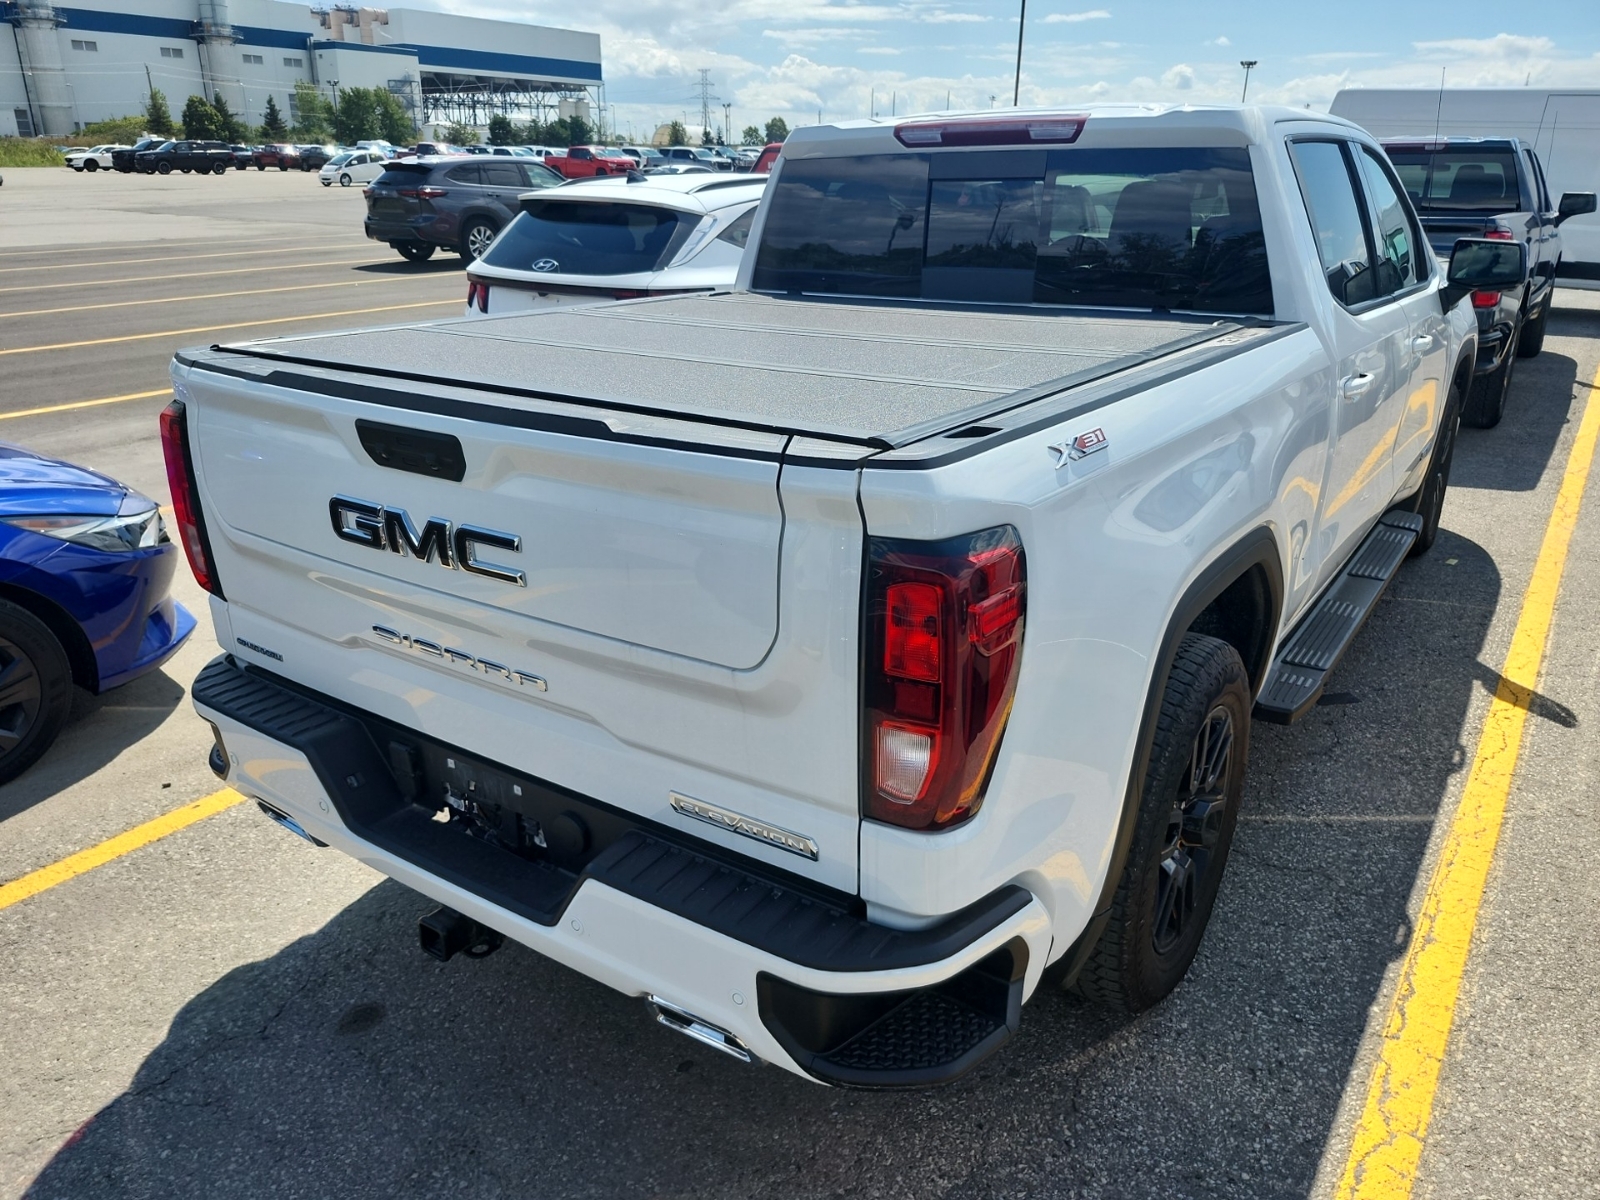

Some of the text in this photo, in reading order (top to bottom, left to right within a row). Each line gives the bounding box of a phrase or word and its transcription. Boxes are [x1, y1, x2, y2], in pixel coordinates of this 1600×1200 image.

[329, 493, 527, 587] GMC
[372, 623, 548, 692] SIERRA
[679, 800, 805, 852] ELEVATION
